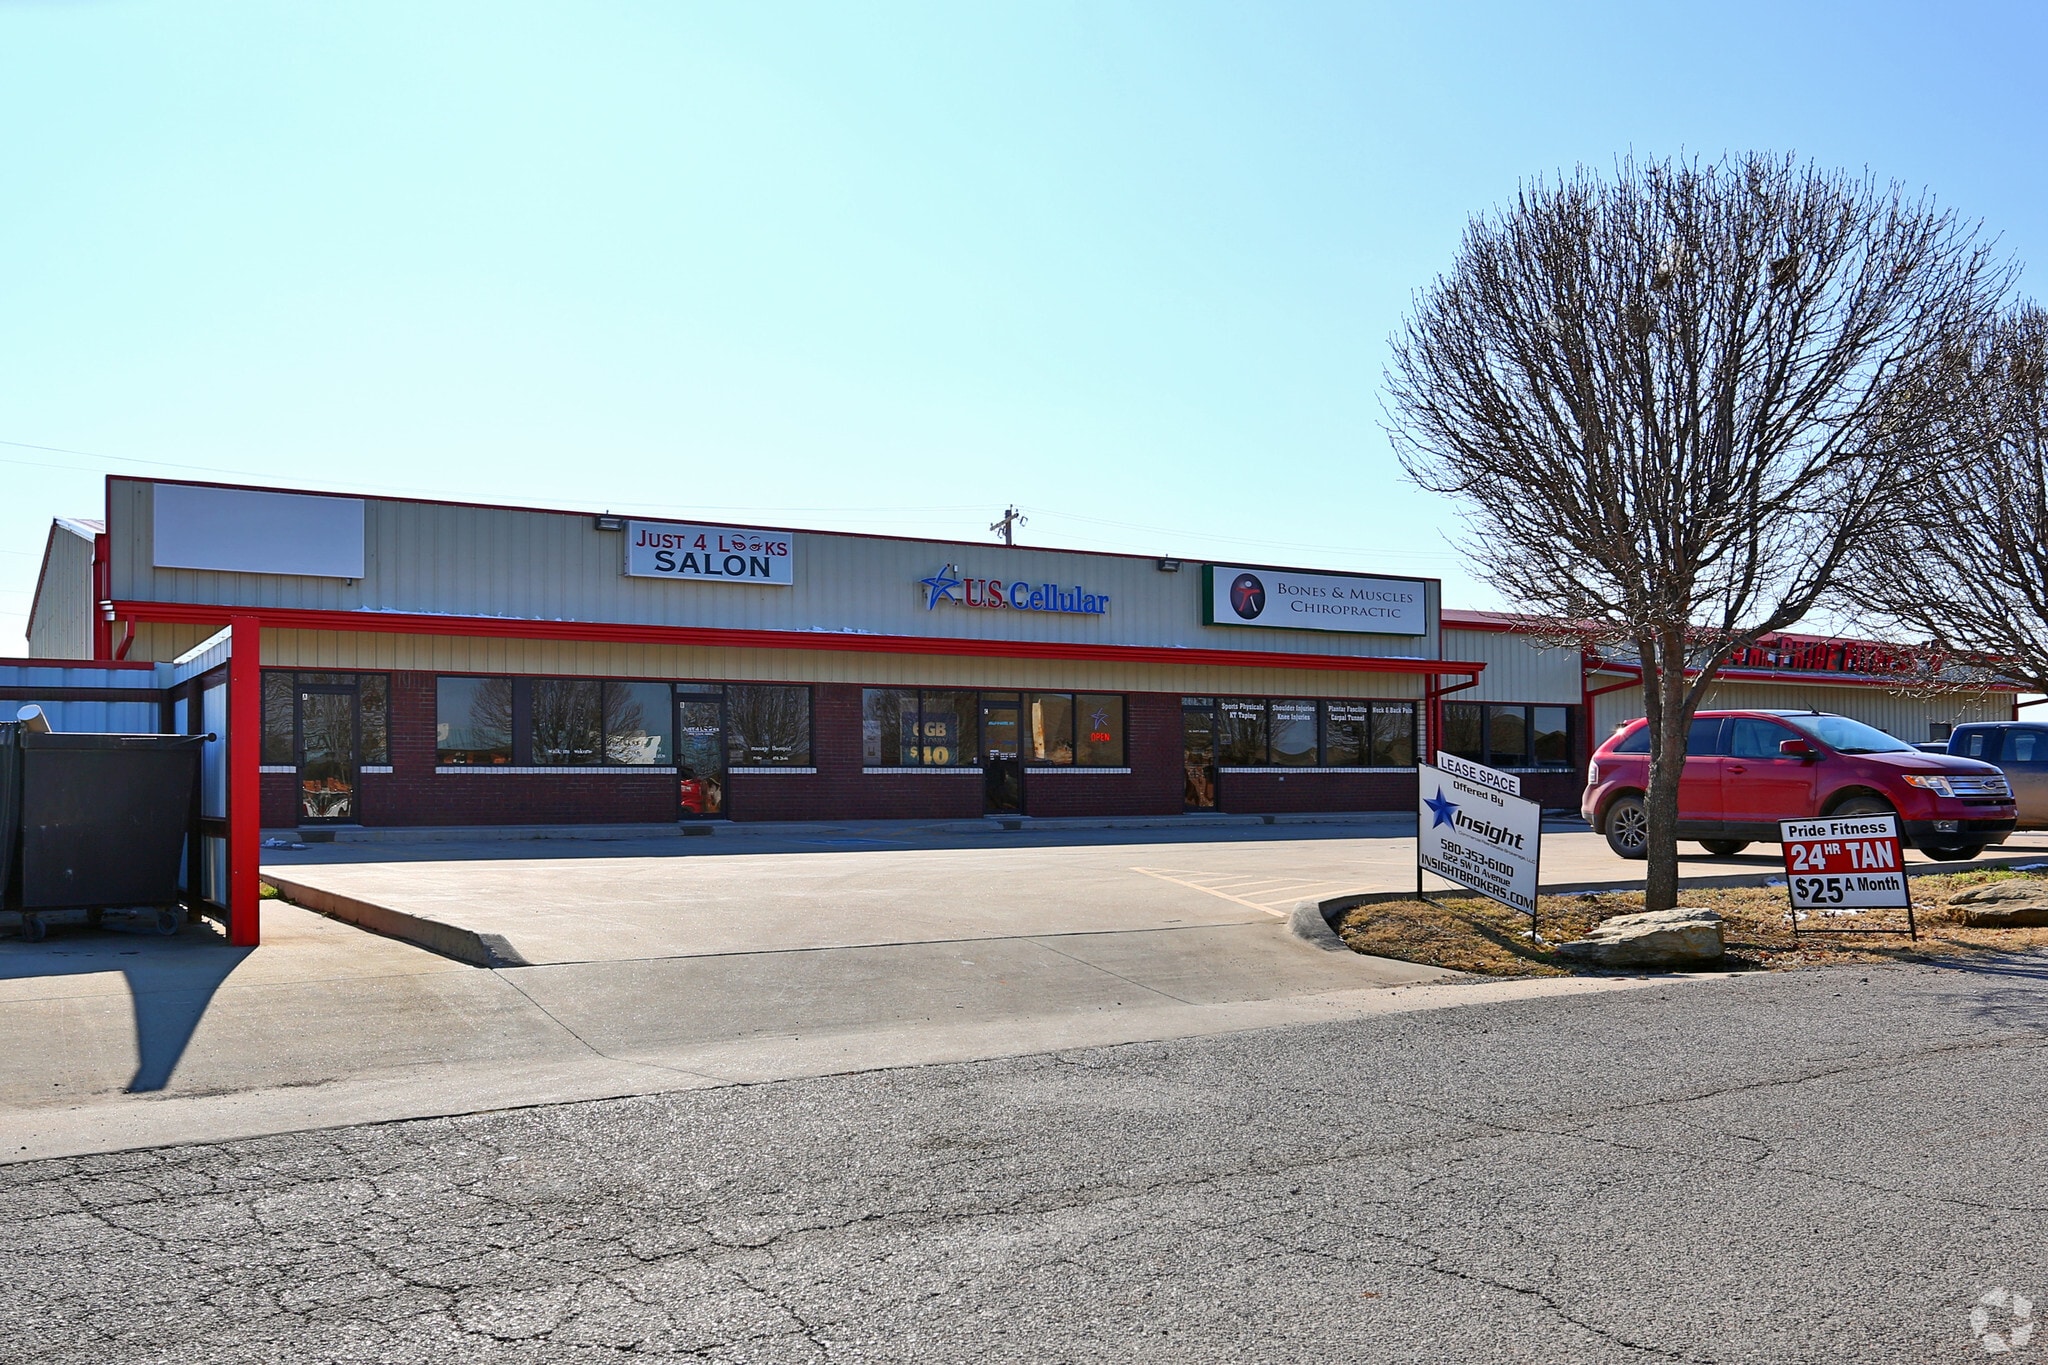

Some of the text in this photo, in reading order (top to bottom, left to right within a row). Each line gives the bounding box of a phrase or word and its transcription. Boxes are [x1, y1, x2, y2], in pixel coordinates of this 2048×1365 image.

[636, 530, 685, 550] JUST
[694, 534, 707, 550] 4
[654, 550, 770, 578] SALON
[964, 578, 1110, 614] U.S. Cellular
[1278, 582, 1414, 604] BONES & MUSCLES
[1290, 600, 1401, 618] CHIROPRACTIC
[1222, 702, 1264, 712] Sports Physicals
[1238, 712, 1256, 720] Taping
[1090, 732, 1111, 742] OPEN
[1440, 756, 1516, 794] LEASE SPACE
[1453, 780, 1504, 807] Offered By
[1455, 810, 1525, 850] Insight
[1789, 822, 1887, 838] Pride Fitness
[1846, 841, 1895, 869] TAN
[1422, 853, 1534, 910] INSIGHTBROKERS.COM
[1442, 852, 1510, 887] 622 SW D Avenue
[1795, 876, 1900, 904] $25 A Month
